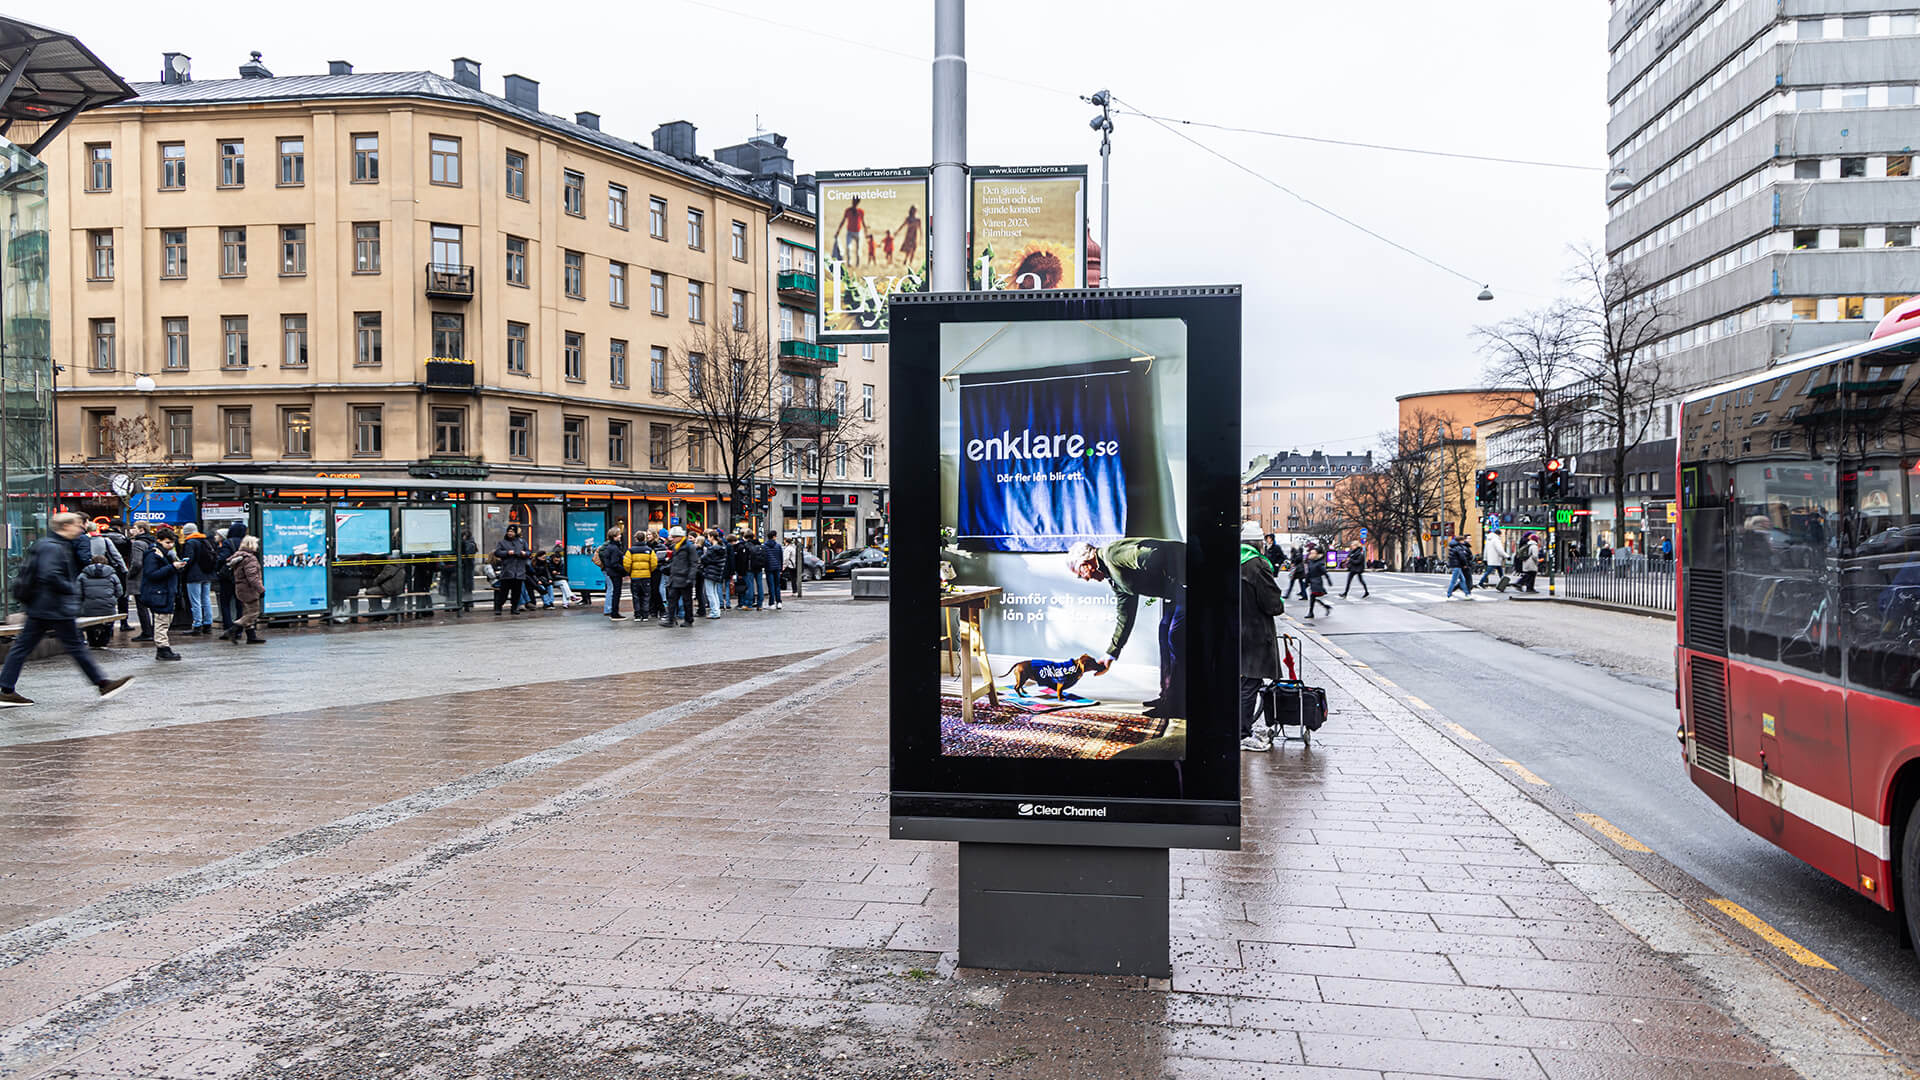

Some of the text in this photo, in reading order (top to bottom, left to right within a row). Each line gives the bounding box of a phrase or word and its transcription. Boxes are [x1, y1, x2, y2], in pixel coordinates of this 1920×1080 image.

[833, 169, 911, 178] www.kulturtavlorna.se
[988, 167, 1068, 175] www.kulturtavlorna.se
[983, 184, 1027, 196] Den sjunde
[983, 194, 1043, 205] himlen och den
[983, 205, 1041, 216] sjunde konsten
[982, 218, 1007, 227] Våren
[983, 229, 1022, 238] Filmhuset
[966, 429, 1119, 462] enklare.se
[997, 472, 1085, 483] Där fler lån blir ett.
[1000, 592, 1119, 605] Jämför och samla
[1003, 609, 1024, 621] lån
[1027, 609, 1045, 624] på
[1034, 805, 1107, 817] Clear Channel
